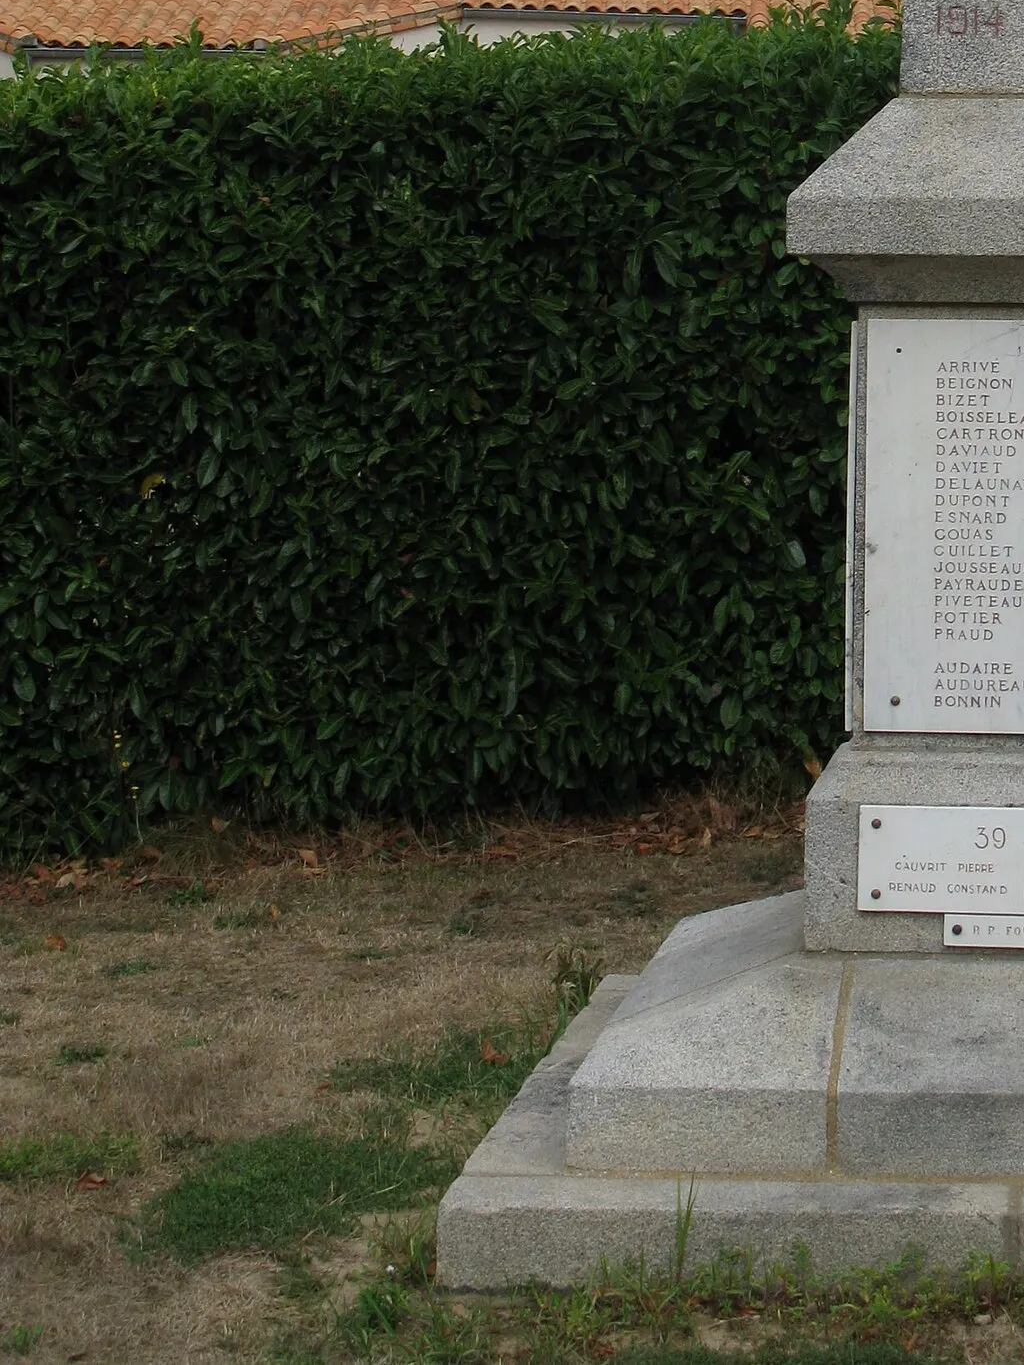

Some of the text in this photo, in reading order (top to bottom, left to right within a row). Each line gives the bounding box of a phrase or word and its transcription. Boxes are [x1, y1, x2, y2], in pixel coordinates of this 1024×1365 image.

[936, 4, 1004, 37] 1914
[936, 377, 1013, 390] BEIGNON
[936, 394, 991, 407] BIZET
[936, 428, 1024, 441] CARTRON
[936, 445, 1017, 457] DAVIAUD
[935, 461, 1003, 473] DAVIET
[935, 495, 1010, 507] DUPONT
[935, 511, 1007, 524] ESNARD
[934, 595, 1023, 608] PIVETEAU
[934, 612, 1002, 625] POTIER
[934, 628, 994, 641] PRAUD
[934, 662, 1014, 674] AUDAIRE
[934, 696, 1001, 708] BONNIN
[974, 827, 1007, 849] 39
[894, 862, 995, 873] CAUVRIT PIERRE
[888, 882, 937, 893] RENAUD
